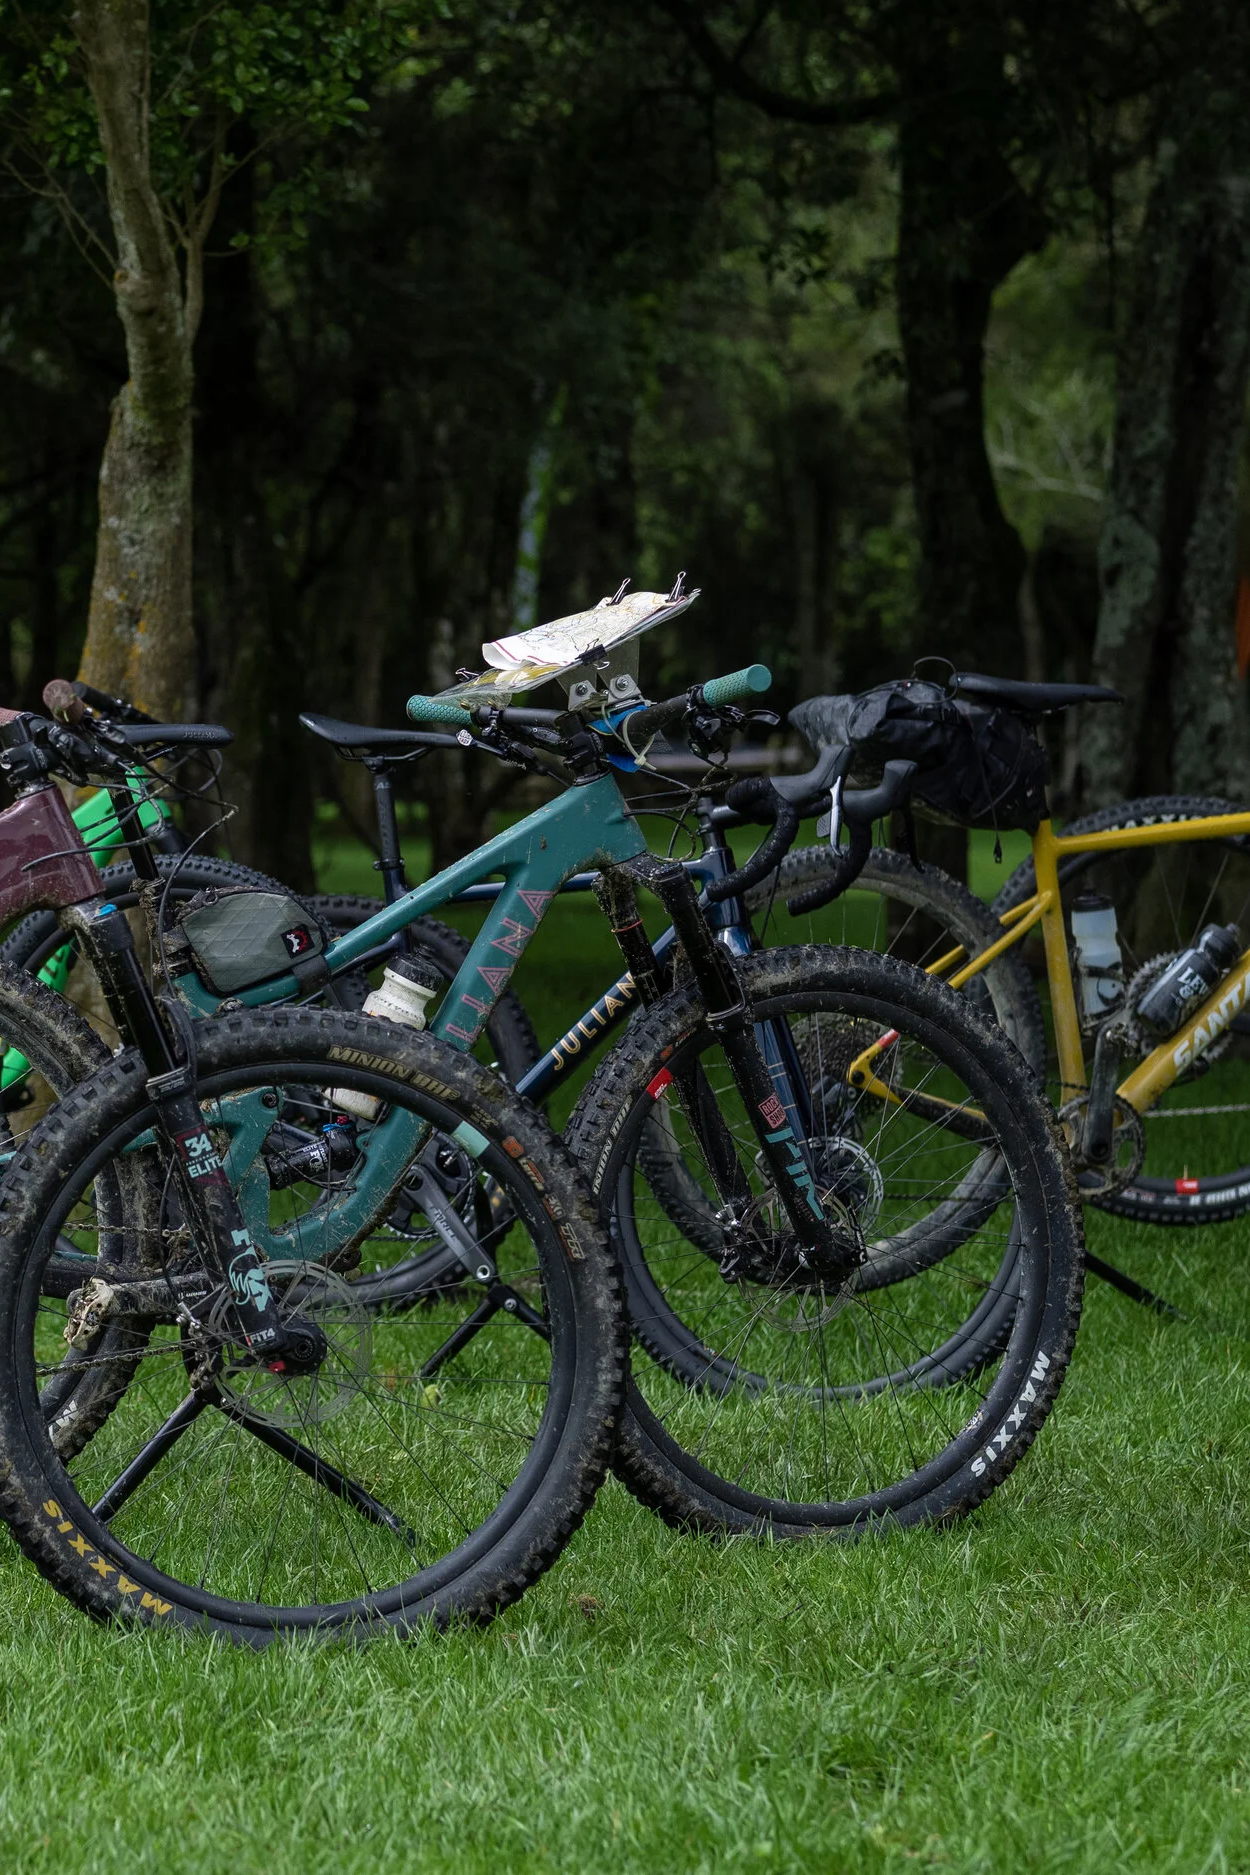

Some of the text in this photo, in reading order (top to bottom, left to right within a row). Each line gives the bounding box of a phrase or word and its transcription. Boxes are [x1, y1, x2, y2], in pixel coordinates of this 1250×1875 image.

[446, 890, 554, 1044] LIANA
[327, 1044, 462, 1102] MINION DHF
[184, 1133, 213, 1157] 34
[187, 1156, 223, 1178] ELITE
[558, 1222, 586, 1260] TR
[970, 1350, 1051, 1478] MAXXIS
[42, 1499, 173, 1616] MAXXIS
